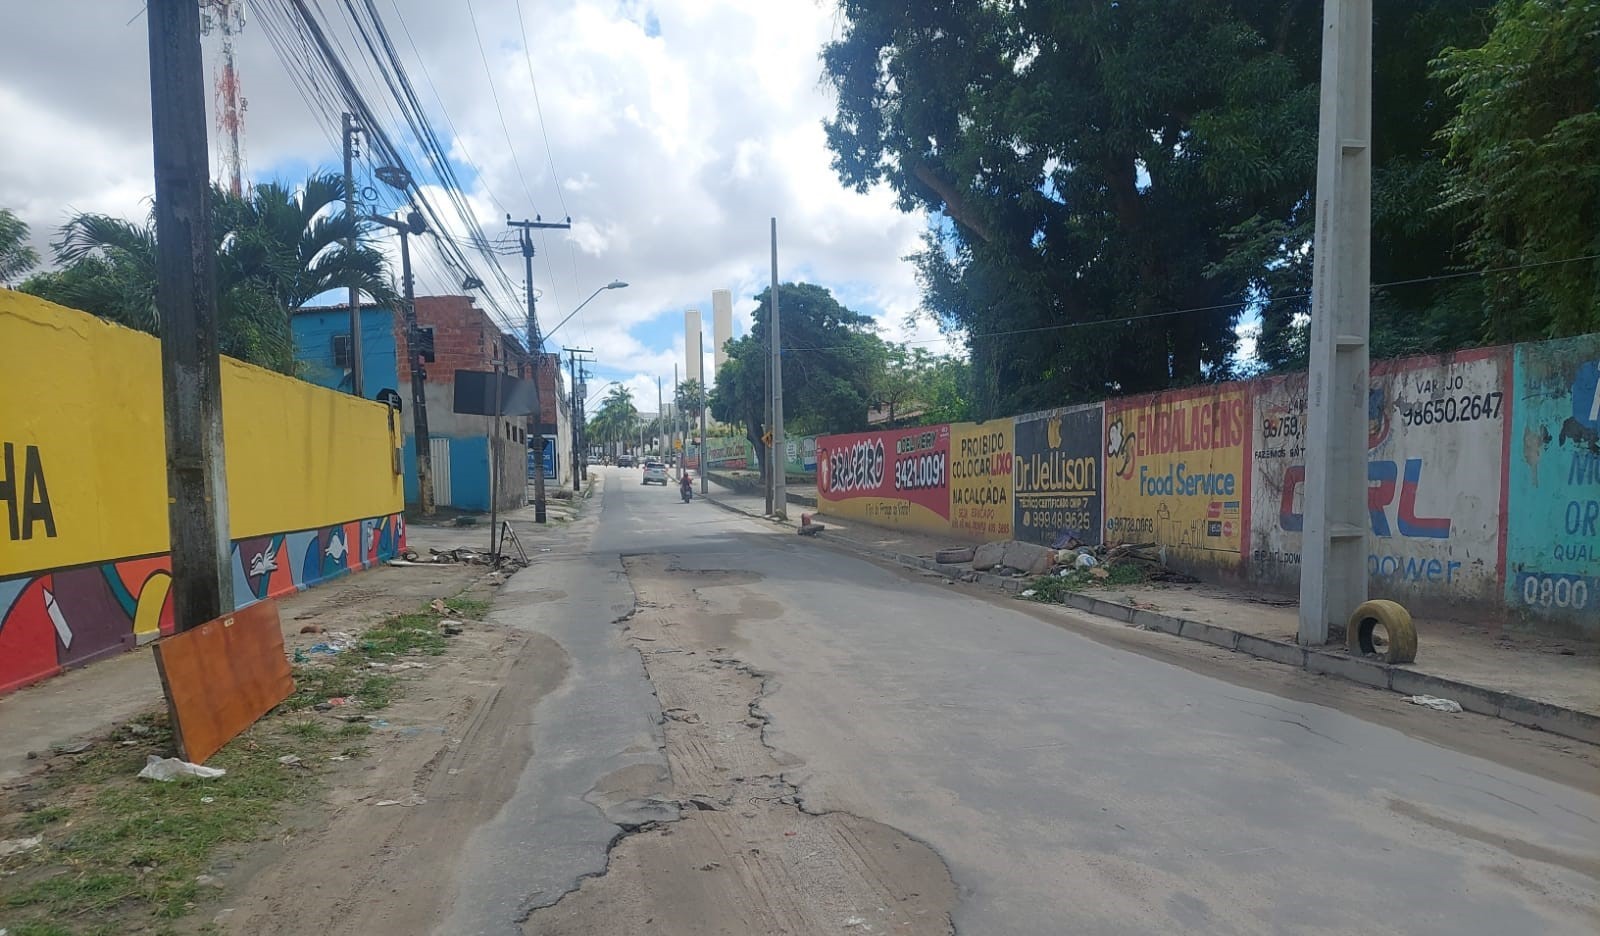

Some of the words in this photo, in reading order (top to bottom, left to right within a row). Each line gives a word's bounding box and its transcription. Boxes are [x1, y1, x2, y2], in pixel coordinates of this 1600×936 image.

[1416, 376, 1463, 394] VARJO
[1137, 398, 1243, 457] EMBALAGENS
[961, 432, 1004, 458] PROIBIDO
[830, 437, 885, 493] BRASEIRO
[895, 450, 946, 491] 3421.0091
[952, 457, 991, 479] COLOCAR
[990, 451, 1013, 476] LIXO
[1140, 464, 1173, 497] Food
[1176, 463, 1235, 497] Service
[952, 488, 963, 504] NA
[1524, 576, 1588, 610] 0800
